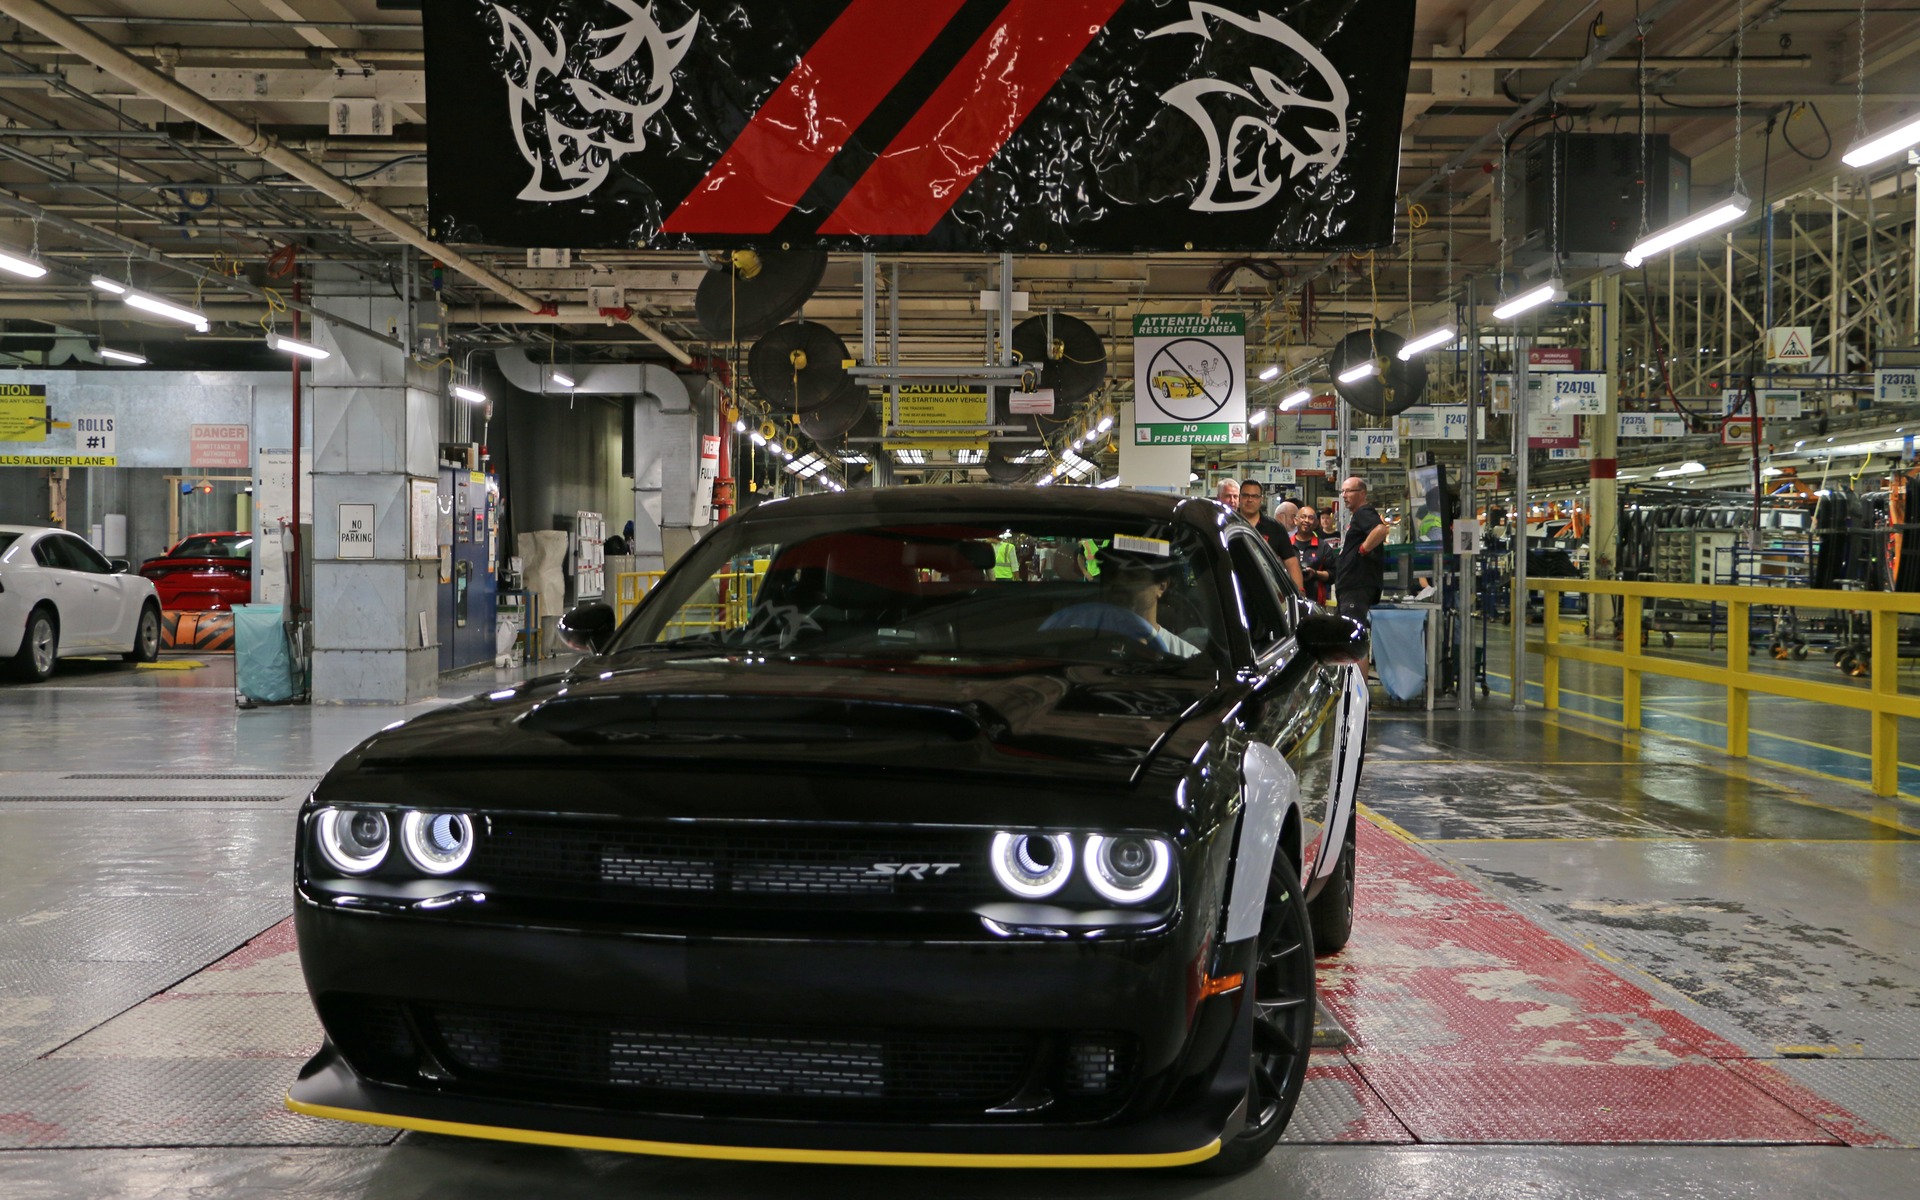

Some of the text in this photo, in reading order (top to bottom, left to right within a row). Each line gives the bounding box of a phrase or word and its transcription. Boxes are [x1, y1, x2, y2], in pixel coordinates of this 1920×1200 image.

[1142, 317, 1232, 326] ATTENTION...
[1882, 374, 1916, 384] F2373L
[1556, 381, 1596, 394] F2479L
[1446, 414, 1466, 424] F247
[78, 419, 114, 431] ROLLS
[194, 428, 245, 438] DANGER
[86, 436, 105, 448] #1
[77, 456, 106, 465] LANE
[352, 520, 362, 529] NO
[342, 533, 372, 543] PARKING
[865, 863, 960, 879] SRT
